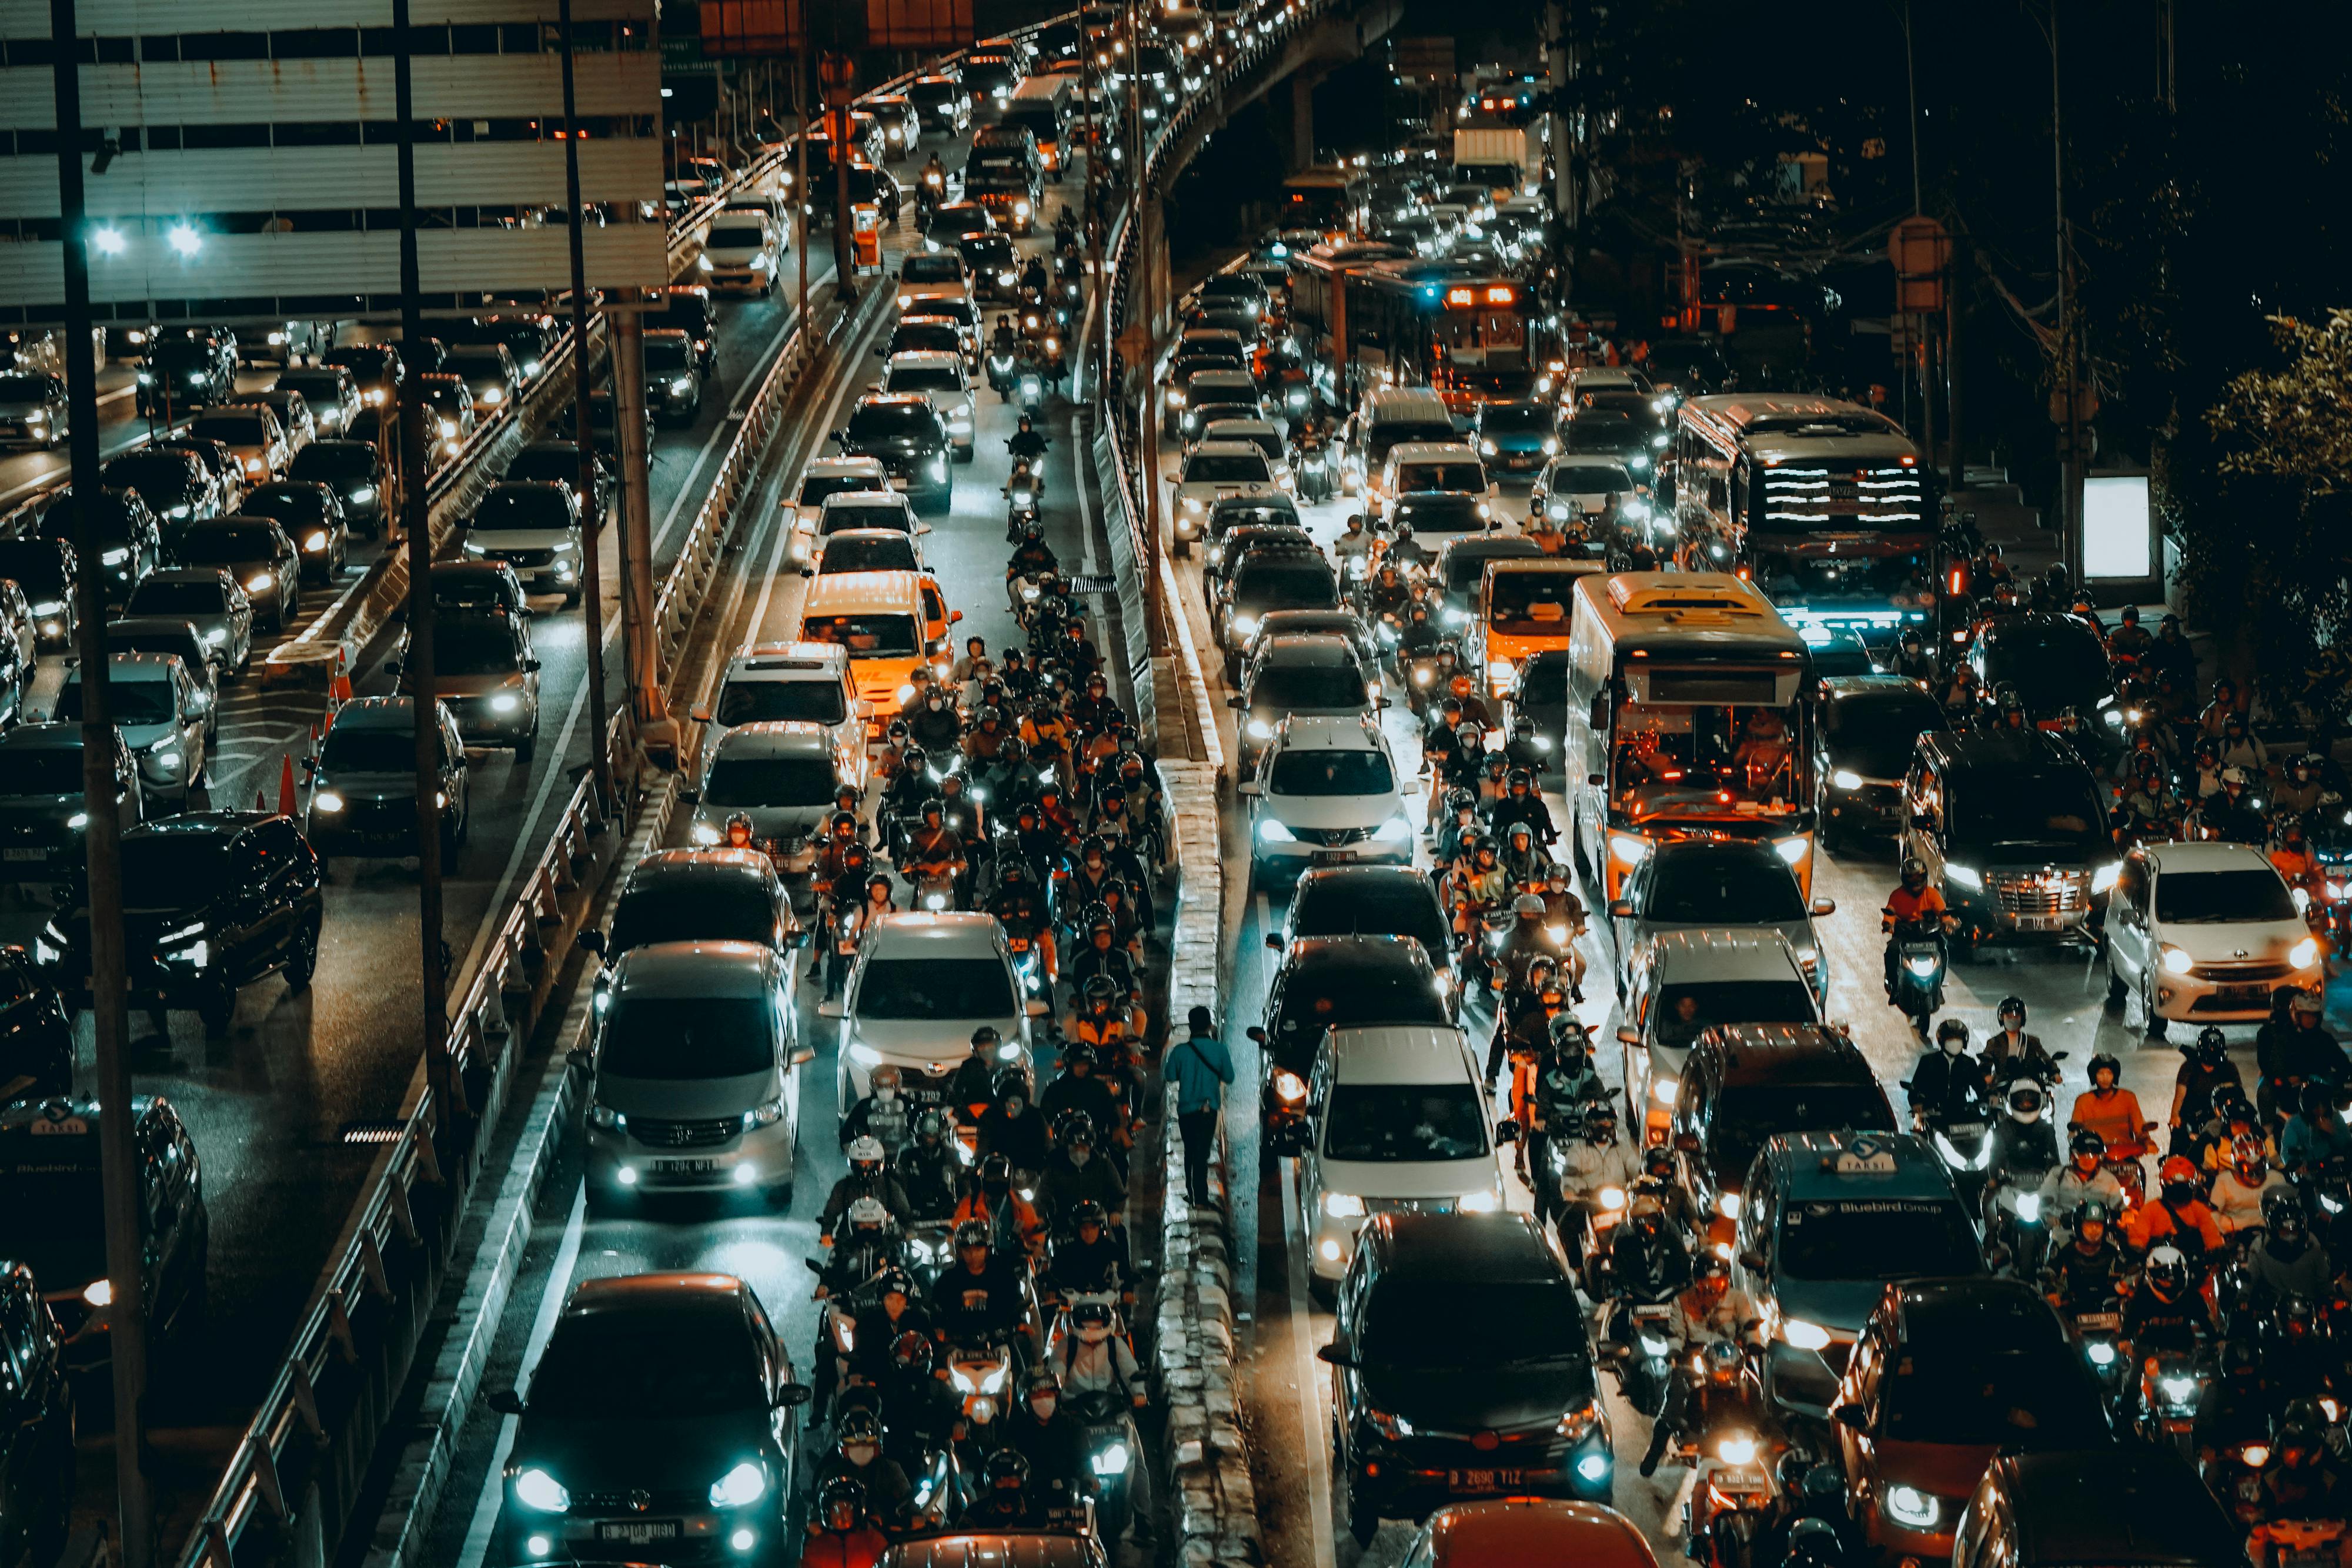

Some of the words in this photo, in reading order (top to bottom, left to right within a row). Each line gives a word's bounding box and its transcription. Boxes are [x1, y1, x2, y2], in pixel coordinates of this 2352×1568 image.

[1847, 1161, 1885, 1170] TAKSI
[1840, 1201, 1901, 1213] Bluebird
[1903, 1202, 1942, 1214] Group
